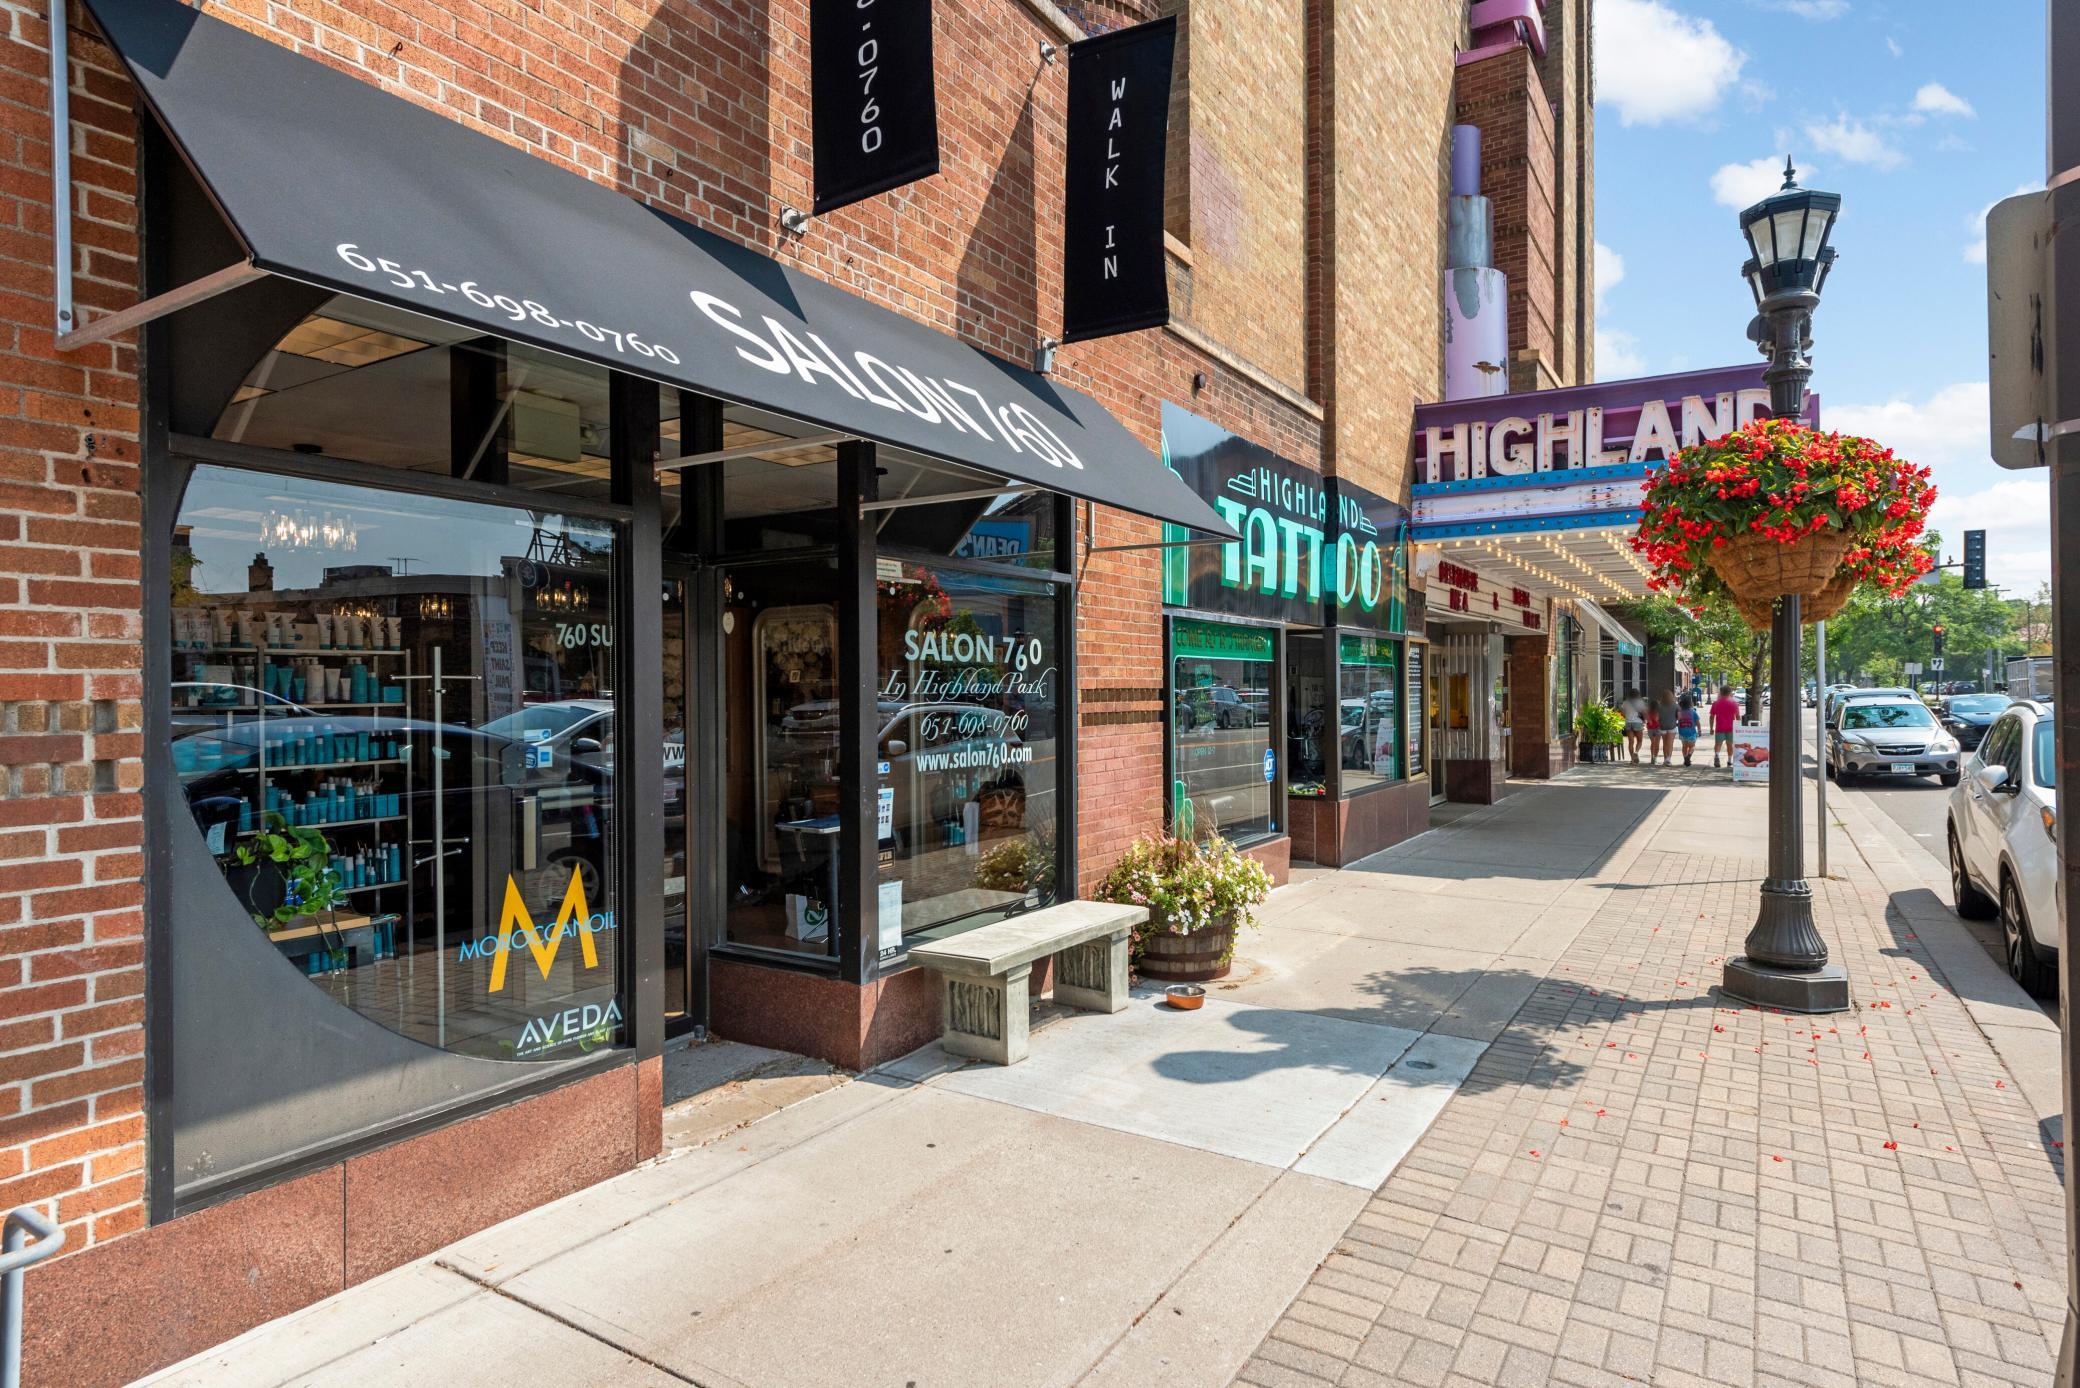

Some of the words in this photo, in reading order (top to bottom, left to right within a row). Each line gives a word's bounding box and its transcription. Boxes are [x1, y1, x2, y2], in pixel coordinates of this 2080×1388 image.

[856, 0, 882, 153] -0760
[1105, 77, 1126, 189] WALK
[1104, 225, 1118, 279] IN
[336, 243, 680, 365] 651-698-0760
[689, 290, 994, 442] SALON
[943, 378, 1084, 470] 760
[1260, 466, 1358, 530] HIGHLAND
[1215, 495, 1382, 610] TATTOO
[556, 623, 587, 649] 760
[904, 630, 993, 663] SALON
[1002, 636, 1042, 672] 760
[878, 669, 906, 702] In
[911, 667, 1009, 703] Highland
[1005, 667, 1057, 699] Park
[920, 709, 1029, 741] 651-698-0760
[916, 742, 1032, 772] www.salon760.com
[459, 911, 618, 962] MOROCCANOIL
[488, 863, 599, 993] M
[516, 998, 623, 1049] AVEDA
